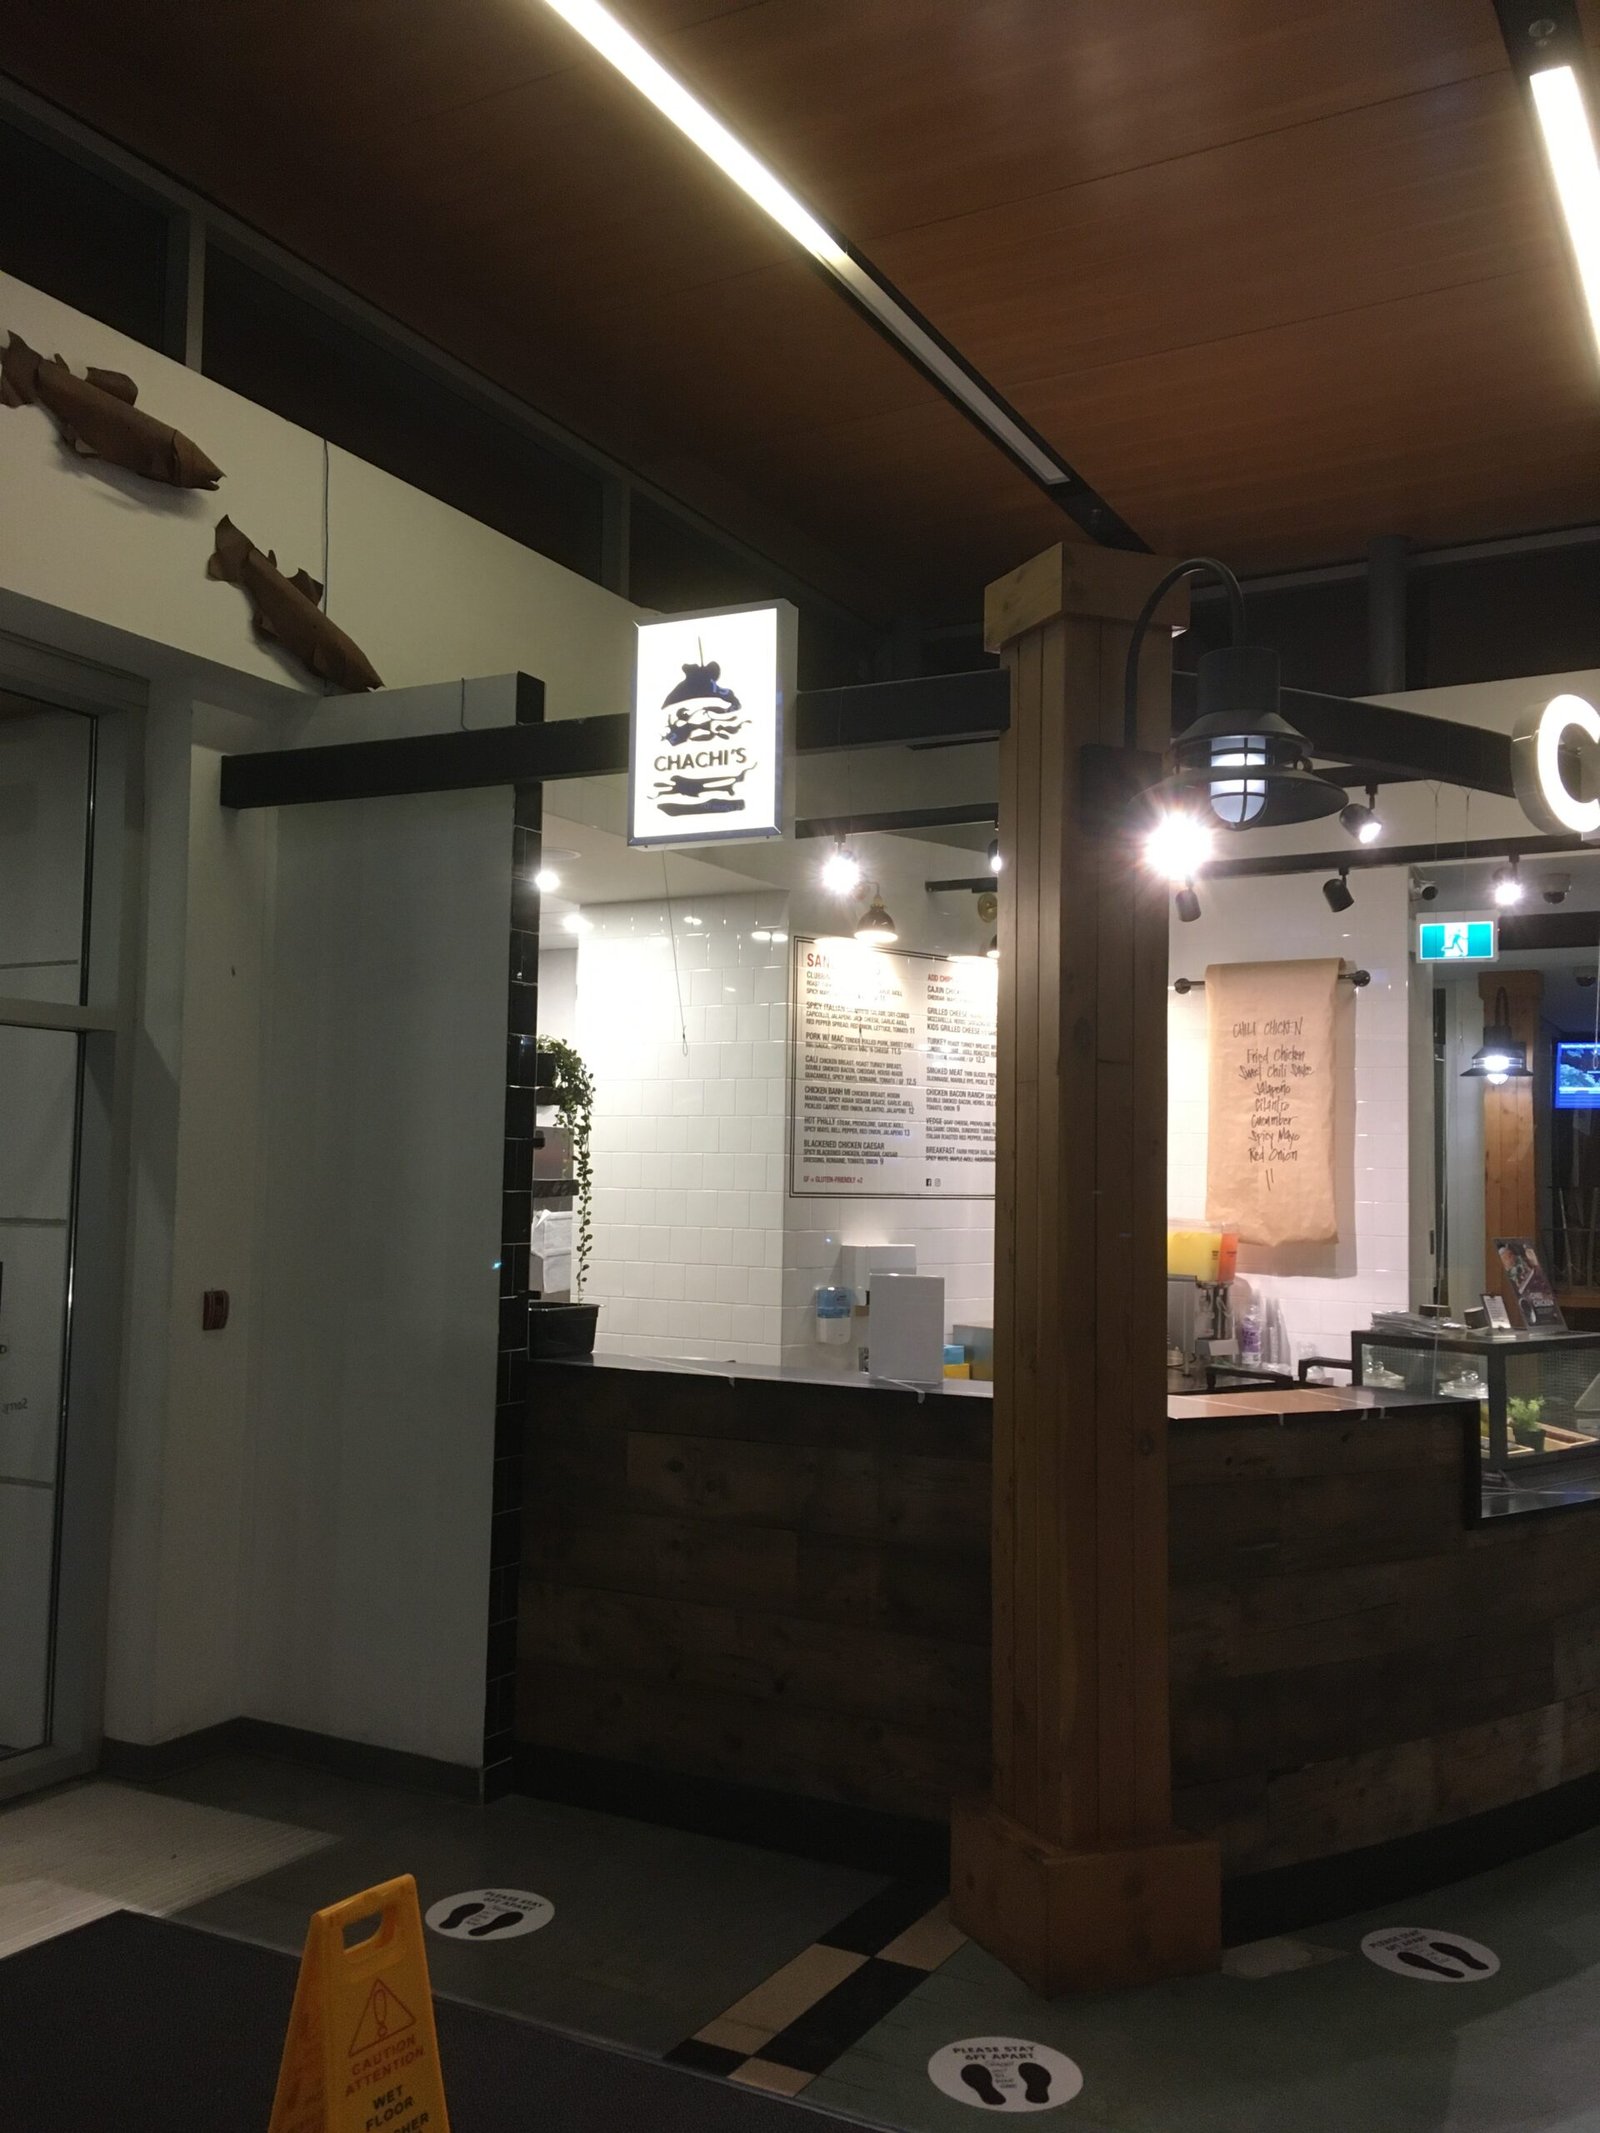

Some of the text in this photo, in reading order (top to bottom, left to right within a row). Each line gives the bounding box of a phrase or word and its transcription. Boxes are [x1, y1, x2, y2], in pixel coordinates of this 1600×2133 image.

[654, 747, 747, 773] CHACHI'S
[928, 985, 944, 993] CAJUN
[806, 1001, 822, 1010] SPICY
[927, 1007, 948, 1015] GRILLED
[940, 1024, 960, 1032] GRILLED
[962, 1026, 980, 1034] CHEESE
[1233, 1016, 1303, 1038] CHILI CHICKEN
[806, 1032, 820, 1040] PORK
[831, 1034, 844, 1043] MAC
[928, 1037, 946, 1045] TURKEY
[1247, 1044, 1305, 1064] Fried Chicken
[927, 1067, 948, 1075] SMOKED
[1267, 1063, 1287, 1078] Chili
[926, 1088, 948, 1096] CHICKEN
[805, 1116, 815, 1124] HOT
[817, 1117, 835, 1125] PHILLY
[1251, 1111, 1298, 1128] Cucumber
[804, 1140, 837, 1148] BLACKENED
[838, 1141, 861, 1149] CHICKEN
[1248, 1127, 1300, 1150] Spicy Mayo
[1248, 1146, 1298, 1163] Red Onion
[352, 2034, 416, 2076] CAUTION
[345, 2048, 424, 2097] ATTENTION
[373, 2084, 403, 2110] WET
[366, 2095, 414, 2132] FLOOR
